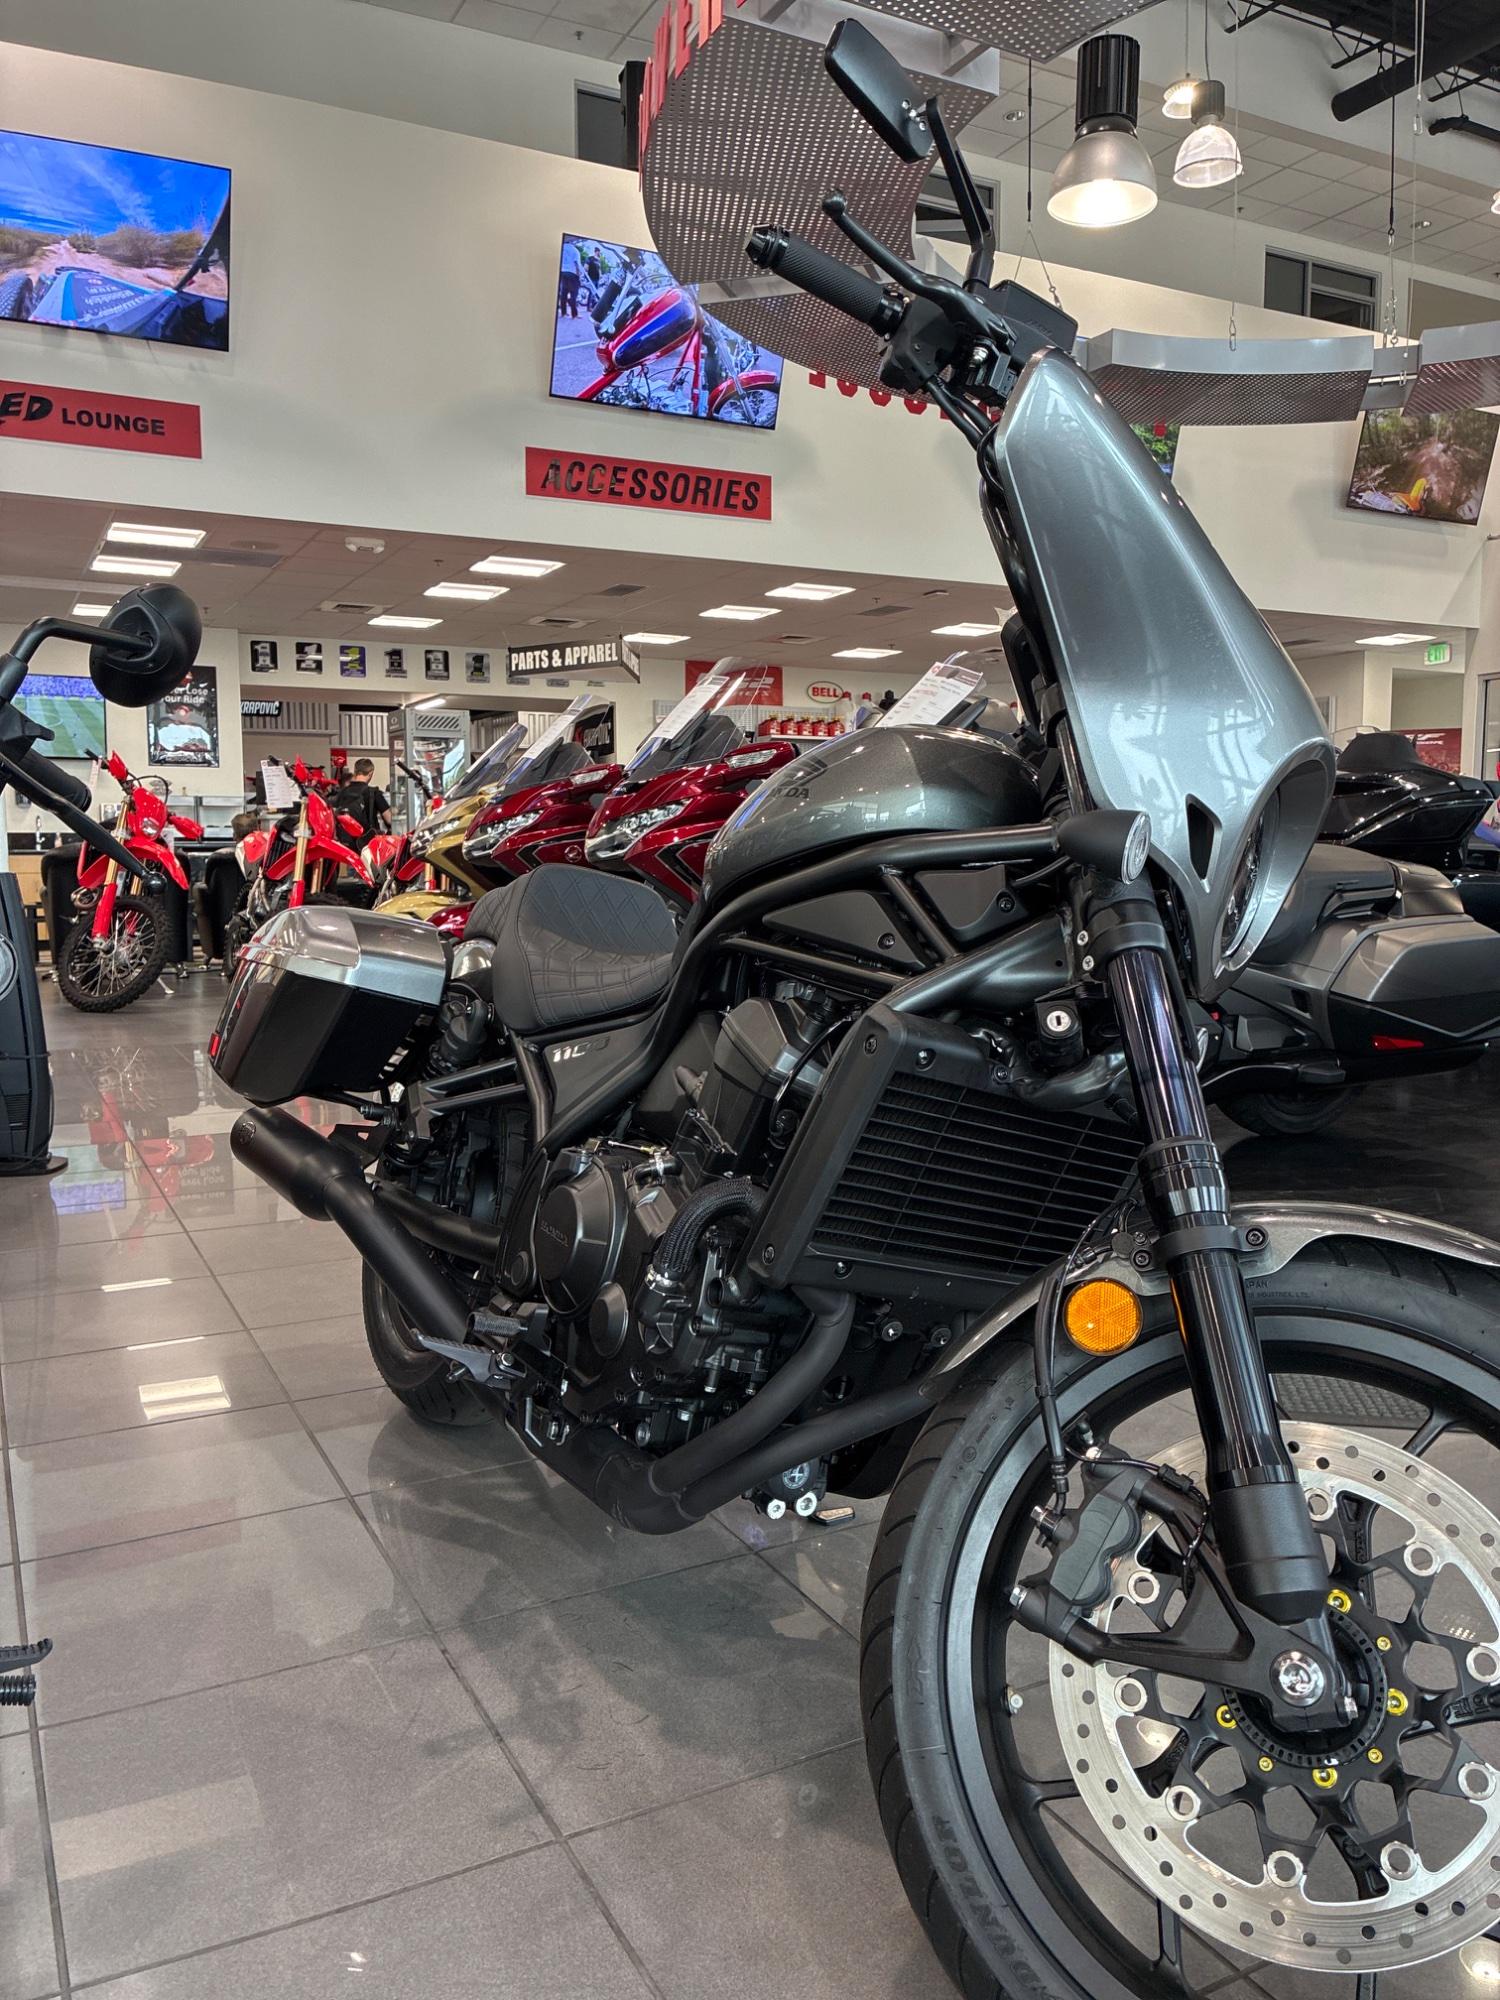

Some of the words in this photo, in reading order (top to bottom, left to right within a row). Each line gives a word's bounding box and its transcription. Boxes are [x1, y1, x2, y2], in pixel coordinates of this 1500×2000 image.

[0, 391, 54, 426] ED
[62, 407, 166, 436] LOUNGE
[541, 458, 761, 512] ACCESSORIES
[511, 650, 549, 672] PARTS
[552, 649, 562, 668] &
[564, 642, 618, 667] APPAREL
[183, 695, 205, 704] Ride
[812, 687, 839, 698] BELL
